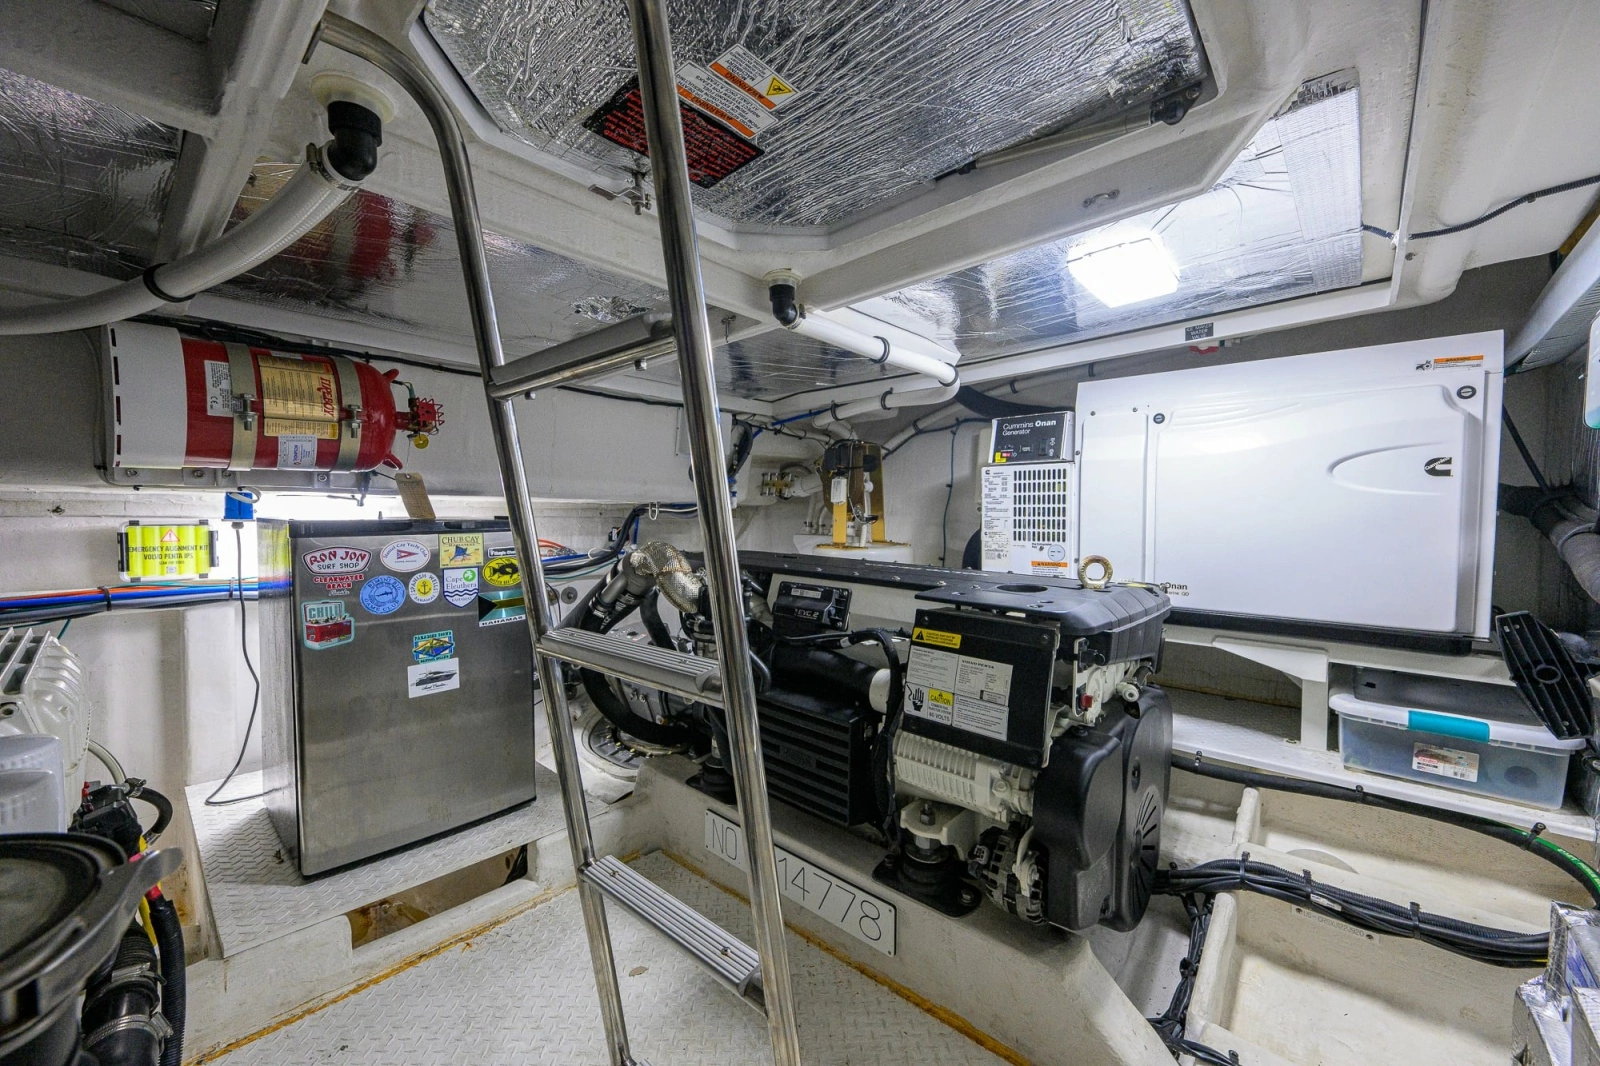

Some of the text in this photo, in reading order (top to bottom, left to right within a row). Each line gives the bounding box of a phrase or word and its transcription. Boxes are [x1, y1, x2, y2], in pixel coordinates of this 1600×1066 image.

[725, 73, 759, 97] WARNING
[692, 96, 727, 119] WARNING
[317, 376, 335, 418] FIREBOY
[1003, 421, 1033, 430] Cummins
[442, 535, 480, 544] CHUB CAY
[309, 551, 367, 565] RON JON
[314, 574, 364, 583] CLEARWATER
[410, 574, 426, 592] SPANISH
[446, 581, 477, 590] Eleuthera
[930, 694, 951, 705] CAUTION
[778, 858, 882, 941] 14778
